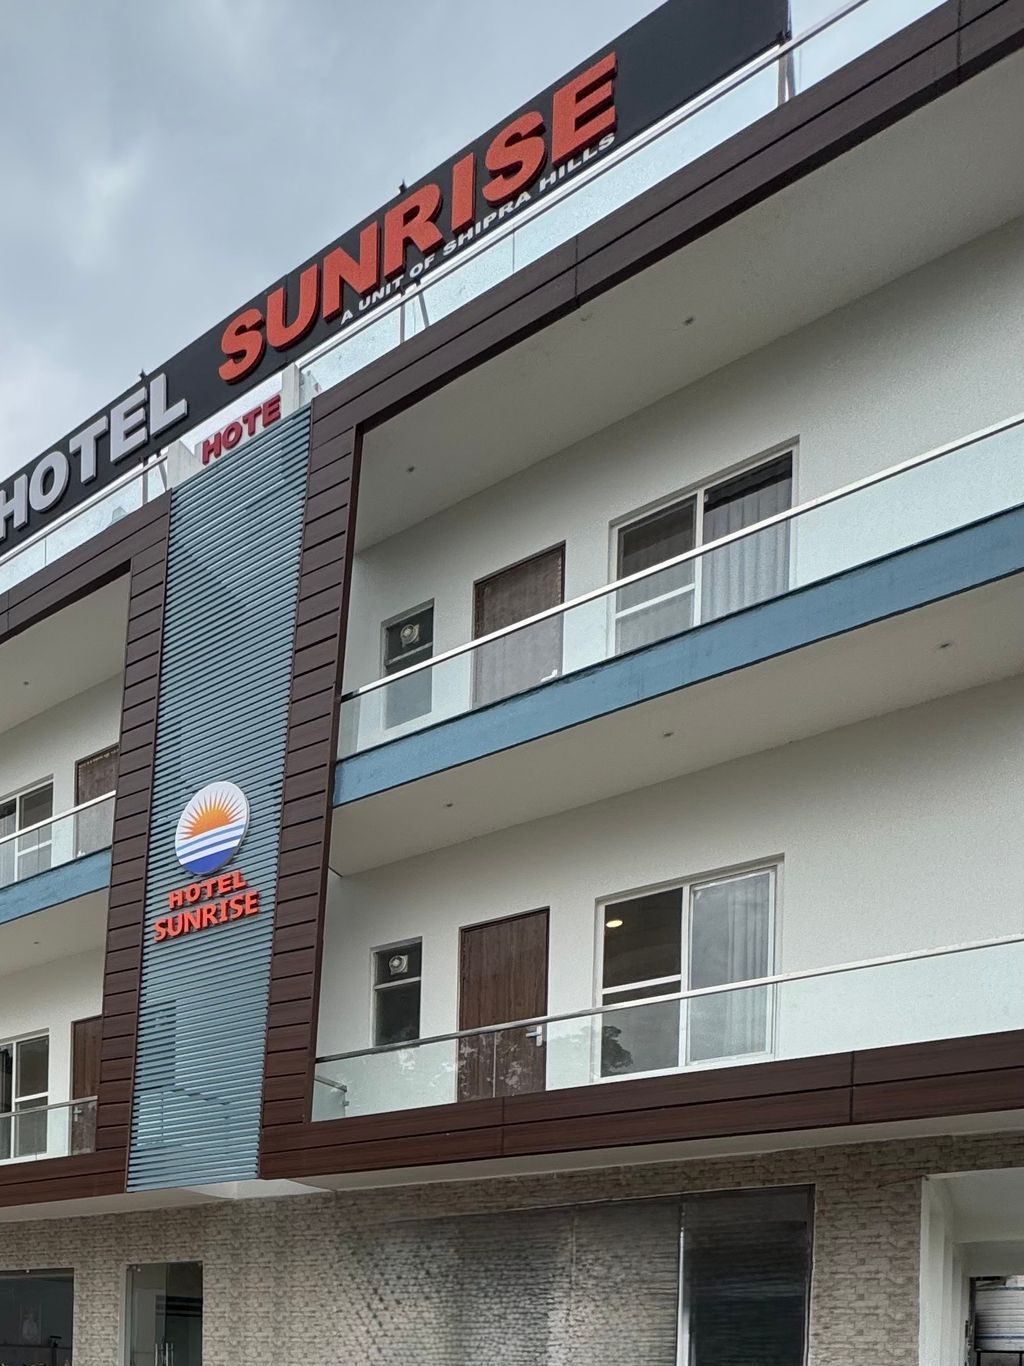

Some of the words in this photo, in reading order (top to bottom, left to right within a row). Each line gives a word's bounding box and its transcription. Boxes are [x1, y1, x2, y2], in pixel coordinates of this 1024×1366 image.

[218, 52, 617, 383] SUNRISE
[340, 312, 354, 326] A
[358, 275, 405, 311] UNIT
[409, 256, 436, 278] OF
[442, 191, 532, 257] SHIPRA
[539, 132, 616, 192] HILLS
[202, 394, 282, 466] HOTE
[153, 890, 262, 942] SUNRISE
[167, 869, 249, 910] HOTEL
